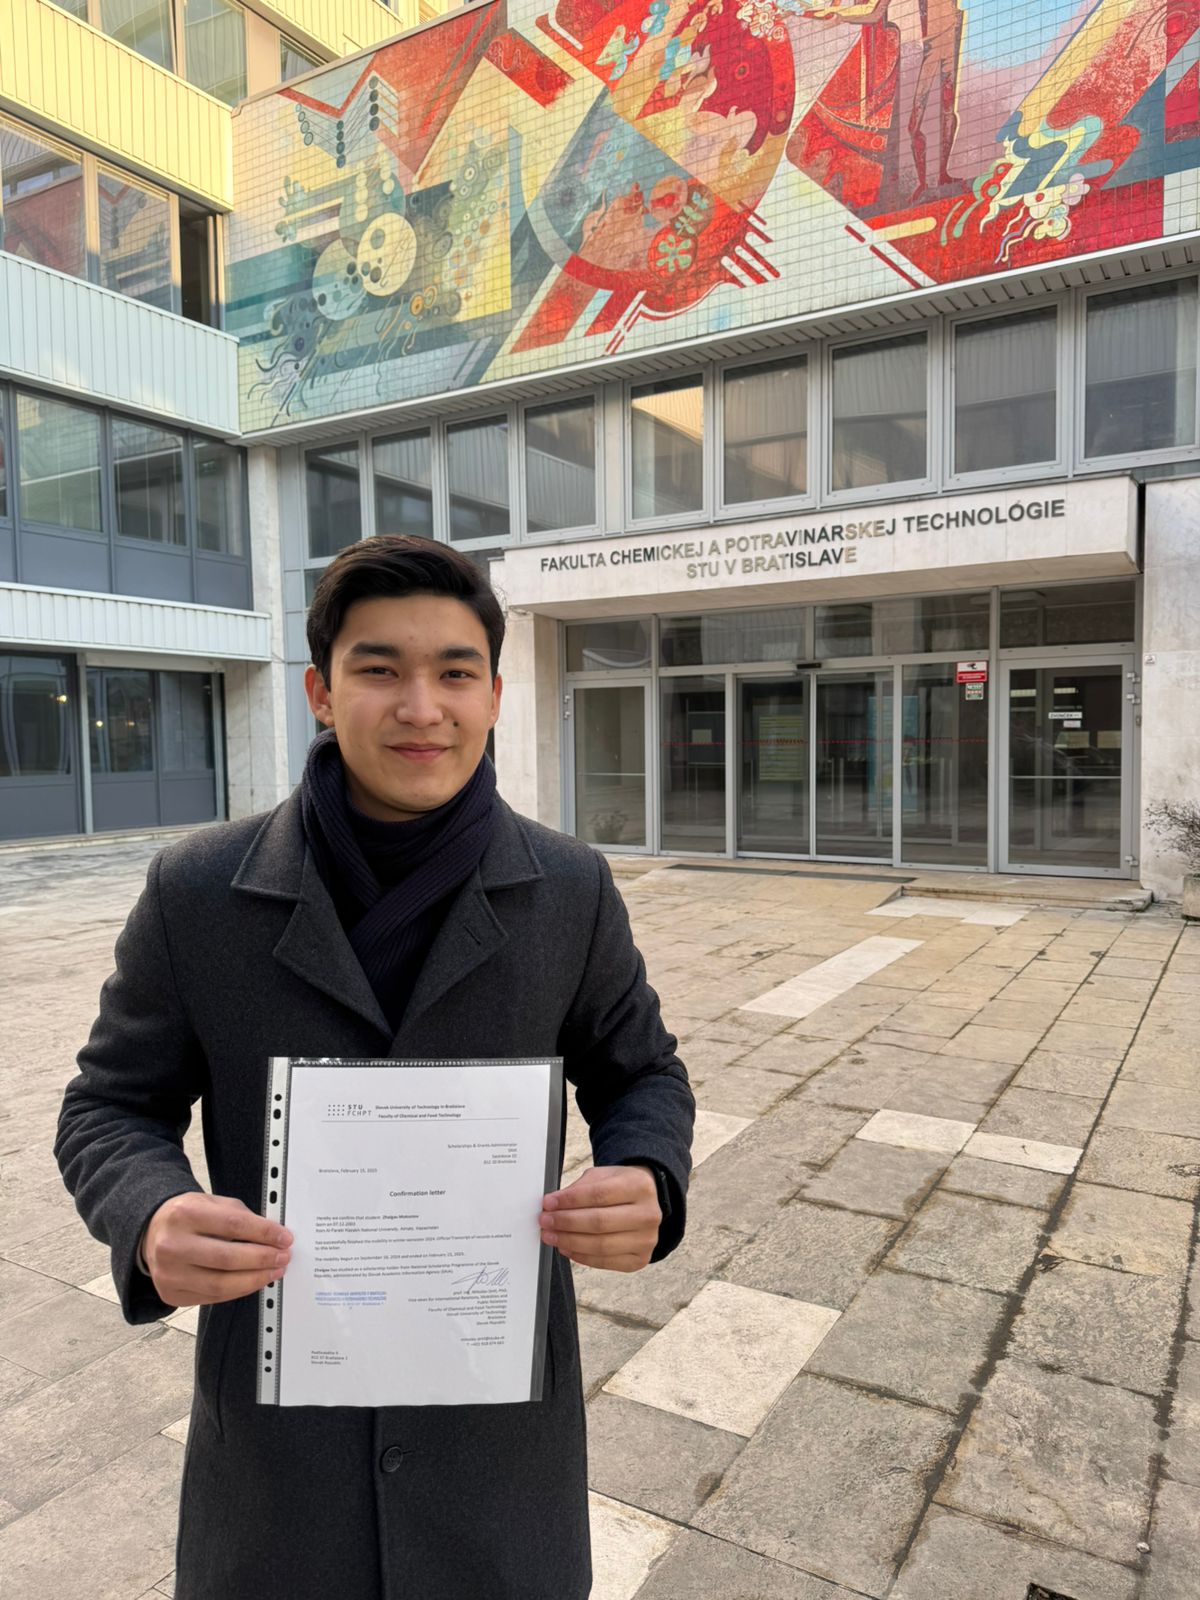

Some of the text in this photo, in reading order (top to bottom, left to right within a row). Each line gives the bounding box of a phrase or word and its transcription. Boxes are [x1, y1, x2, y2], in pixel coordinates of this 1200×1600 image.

[540, 499, 1065, 573] FAKULTA CHEMICKEJ A POTRAVINÁRSKEJ TECHNOLÓGIE
[686, 546, 857, 579] STU V BRATISLAVE
